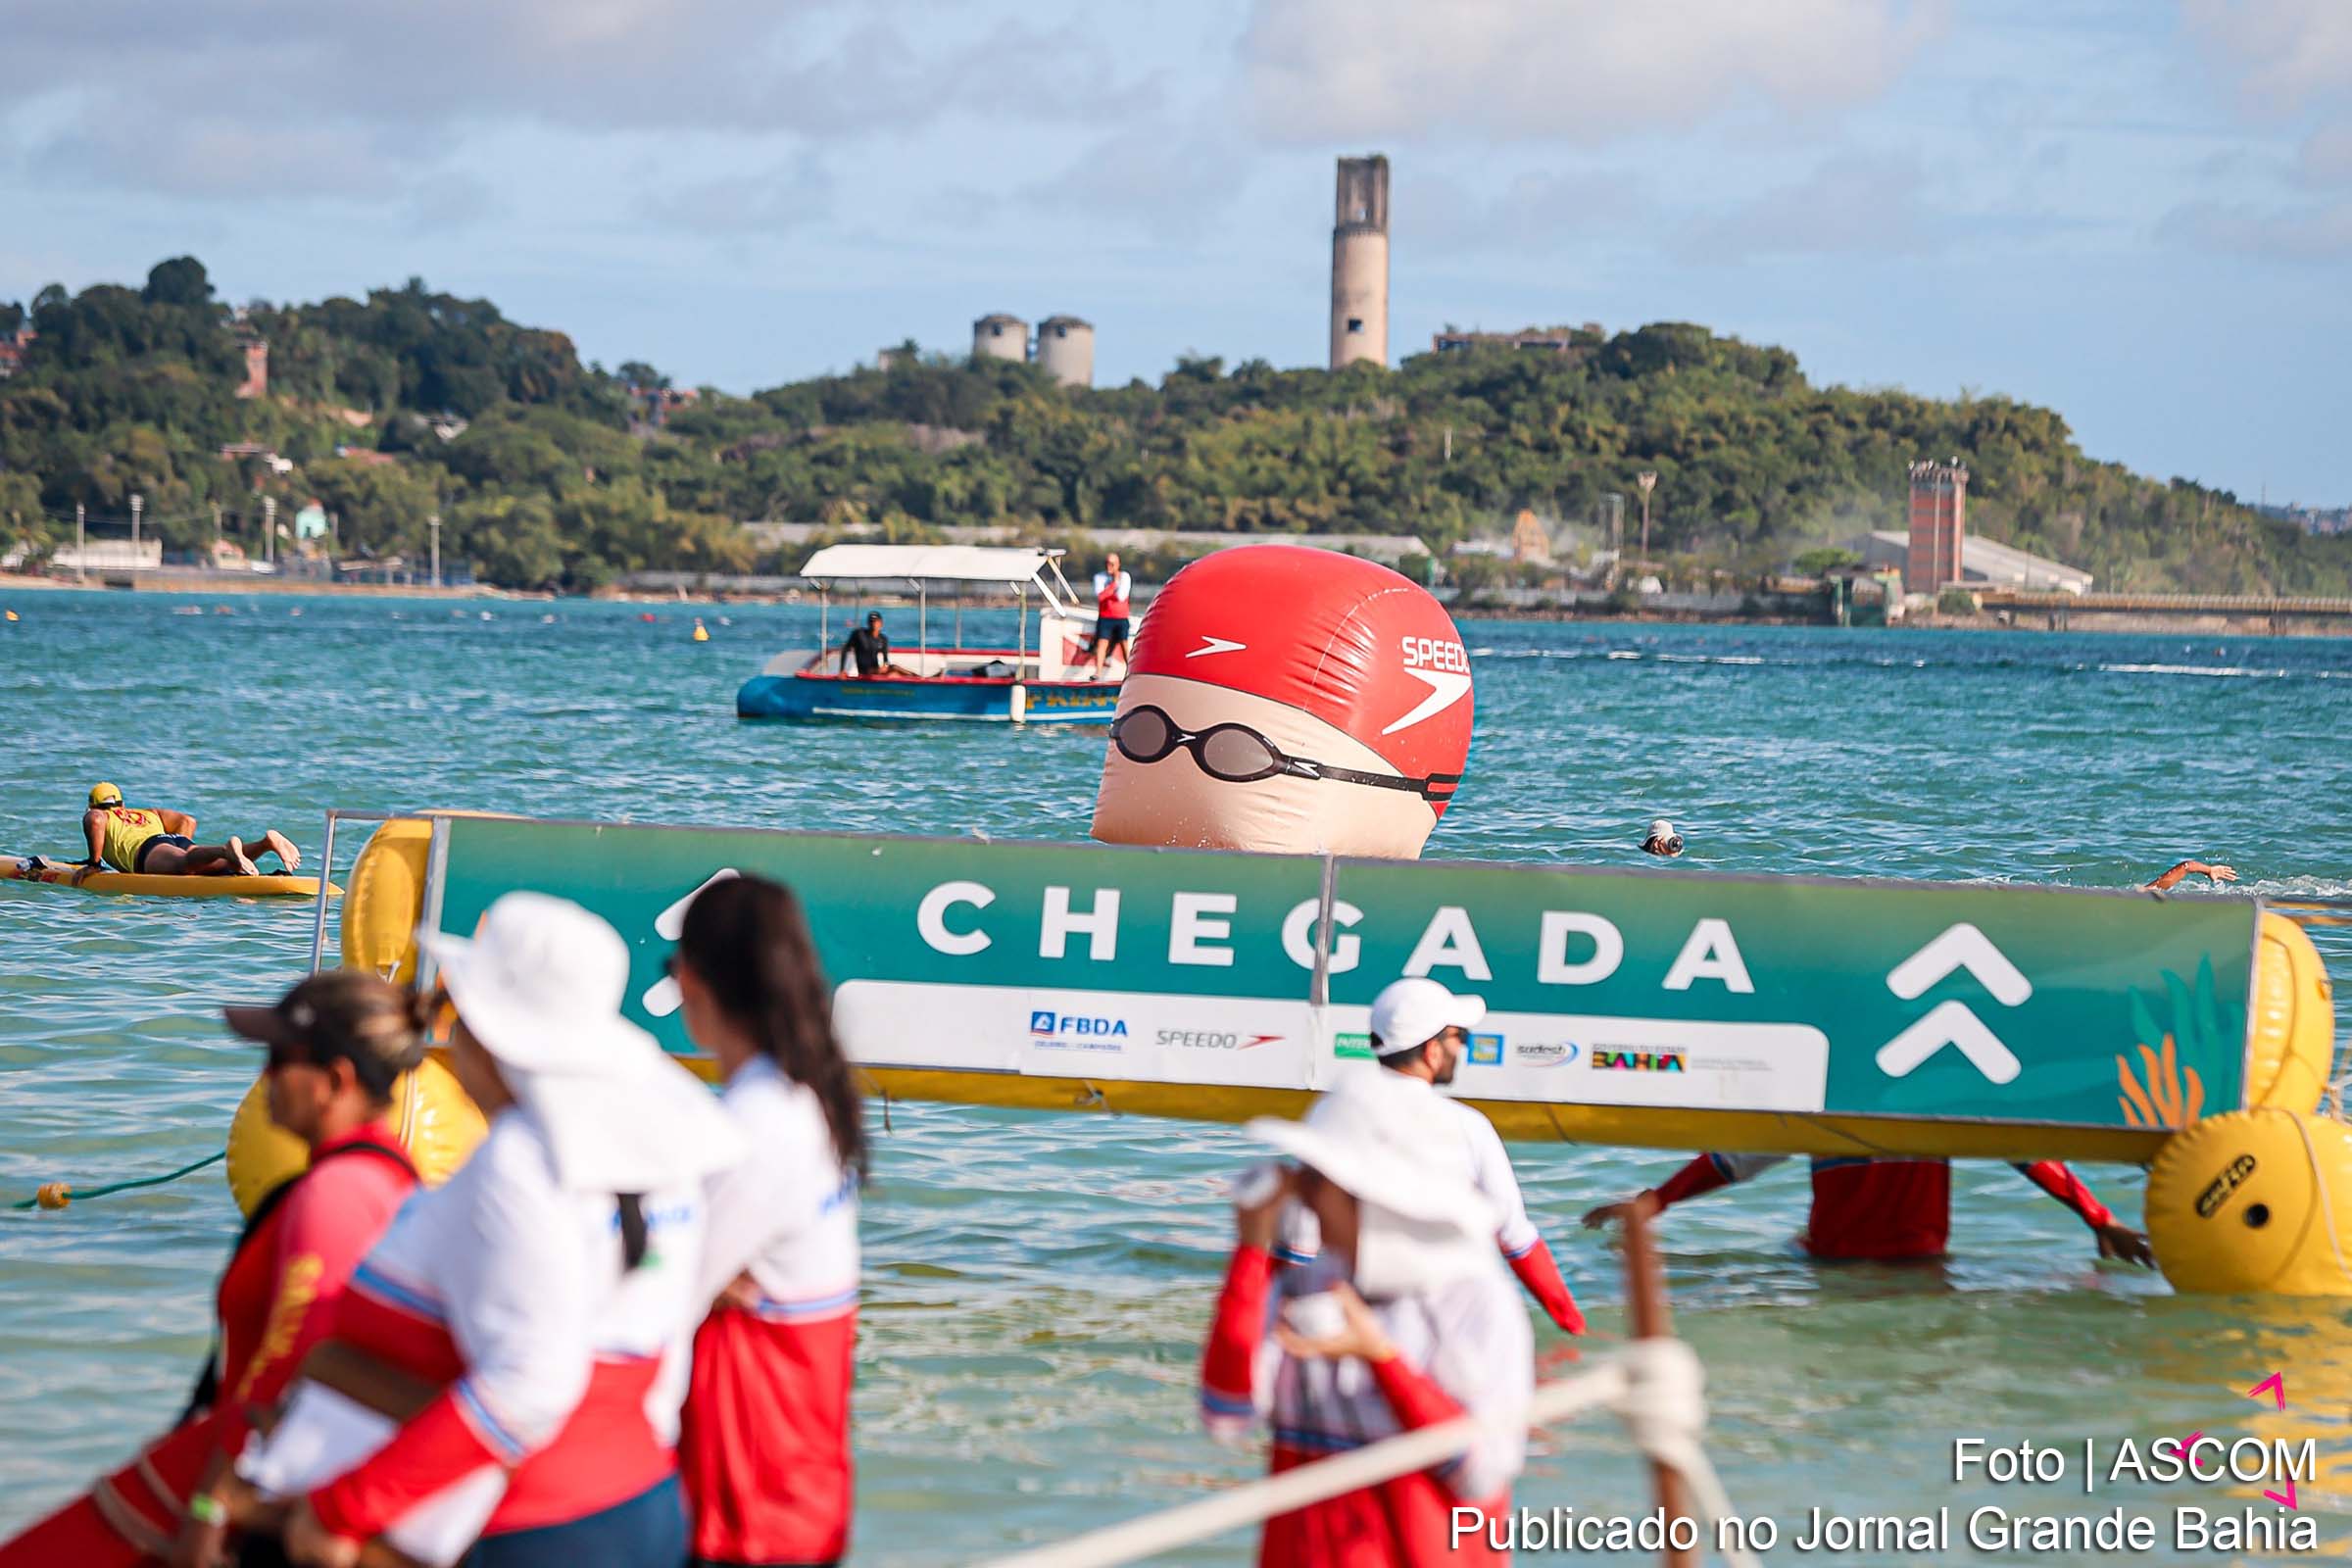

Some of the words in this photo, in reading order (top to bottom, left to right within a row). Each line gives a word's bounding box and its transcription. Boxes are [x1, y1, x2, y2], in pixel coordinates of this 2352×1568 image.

[917, 880, 1755, 994] CHEGADA
[1060, 1016, 1128, 1037] FBDA
[1154, 1029, 1238, 1050] SPEEDO
[1592, 1052, 1687, 1073] BAHIA
